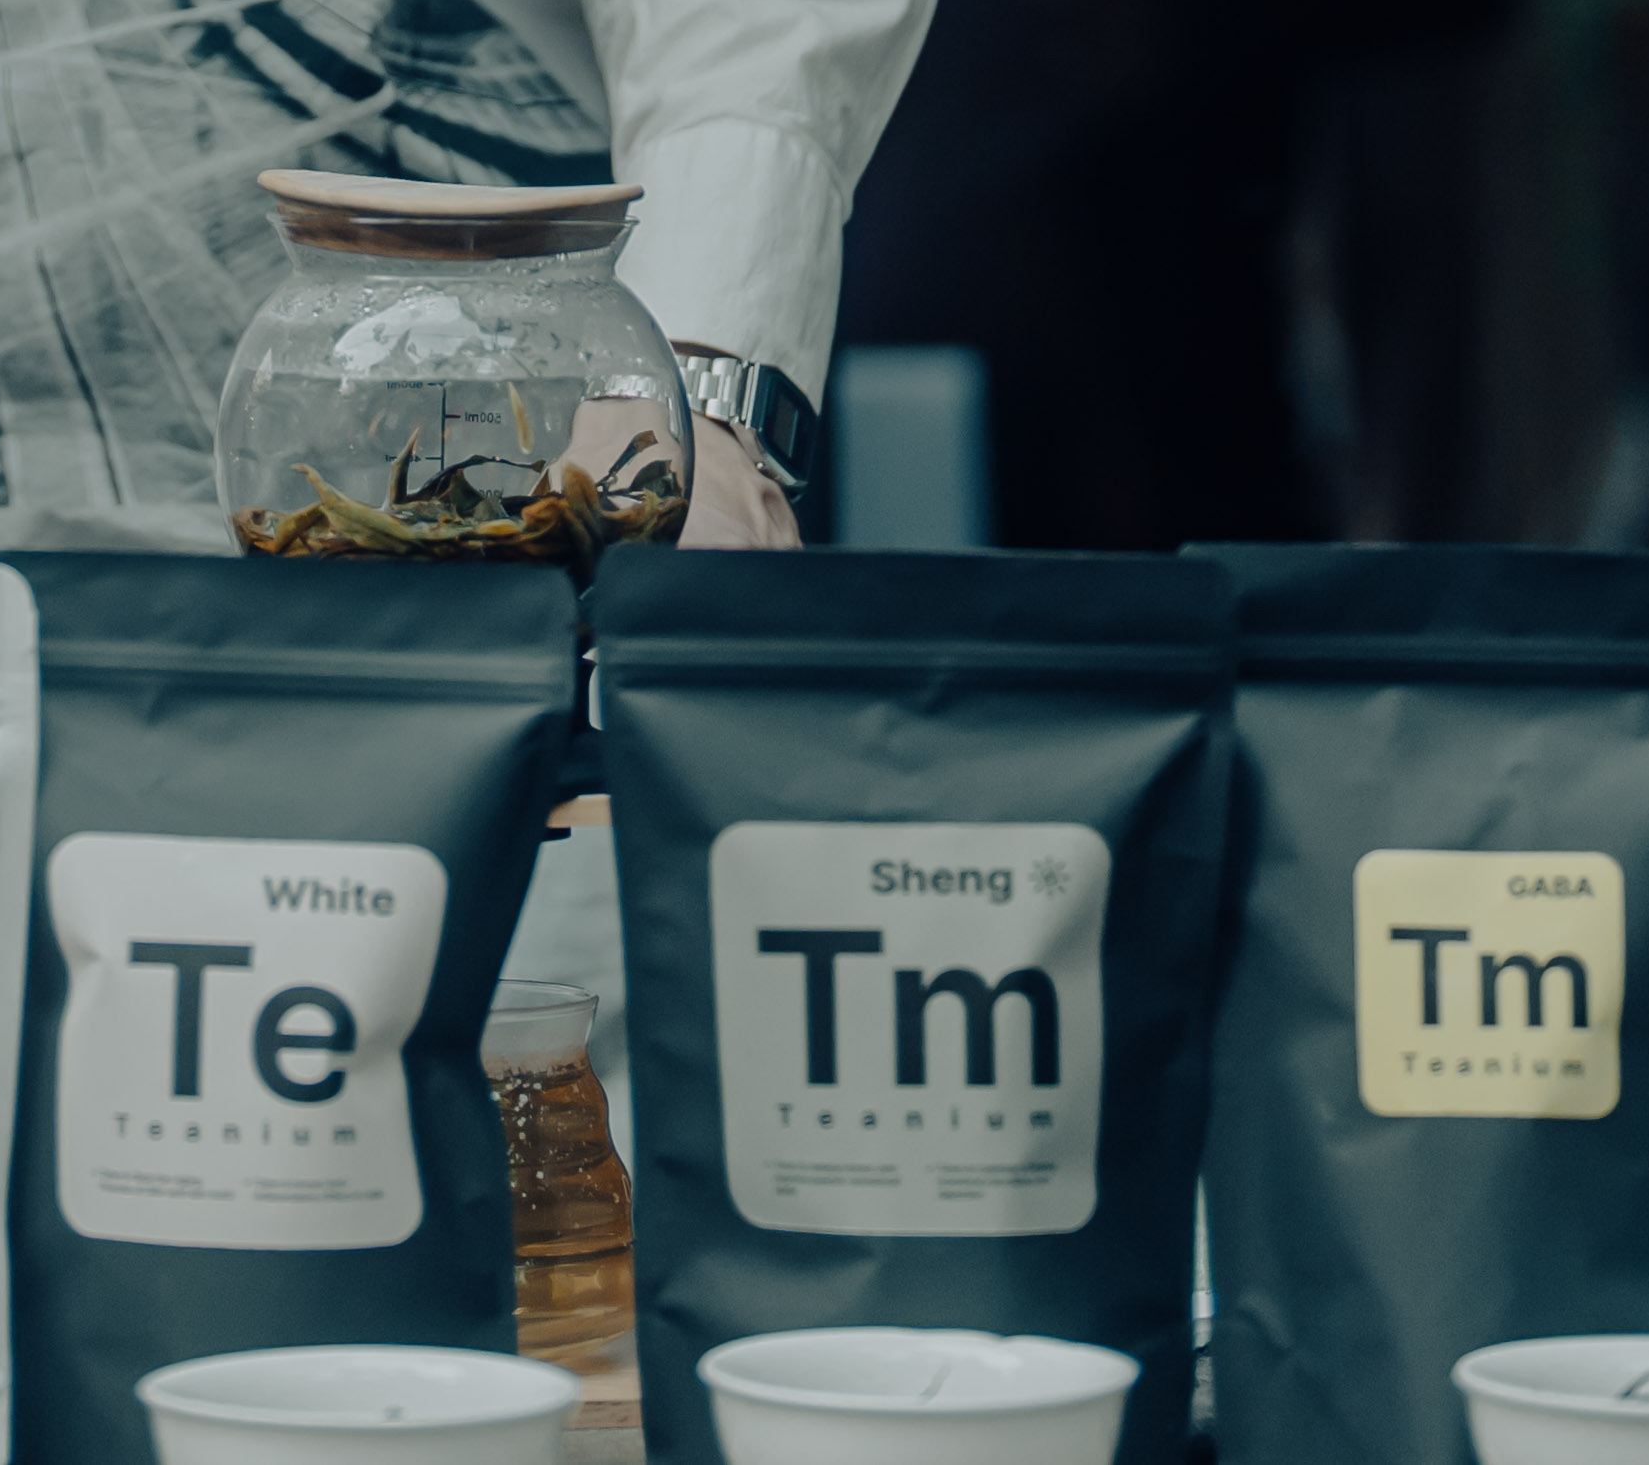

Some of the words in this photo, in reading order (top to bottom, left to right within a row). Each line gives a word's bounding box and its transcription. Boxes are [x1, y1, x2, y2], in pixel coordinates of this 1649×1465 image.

[262, 876, 396, 917] White
[870, 860, 1014, 904] Sheng
[1508, 875, 1594, 898] GABA
[1390, 927, 1589, 1028] Tm
[128, 939, 357, 1103] Te
[757, 929, 1061, 1087] Tm
[1401, 1051, 1586, 1076] Teanium
[112, 1112, 357, 1146] Teanium
[777, 1103, 1054, 1132] Teanium
